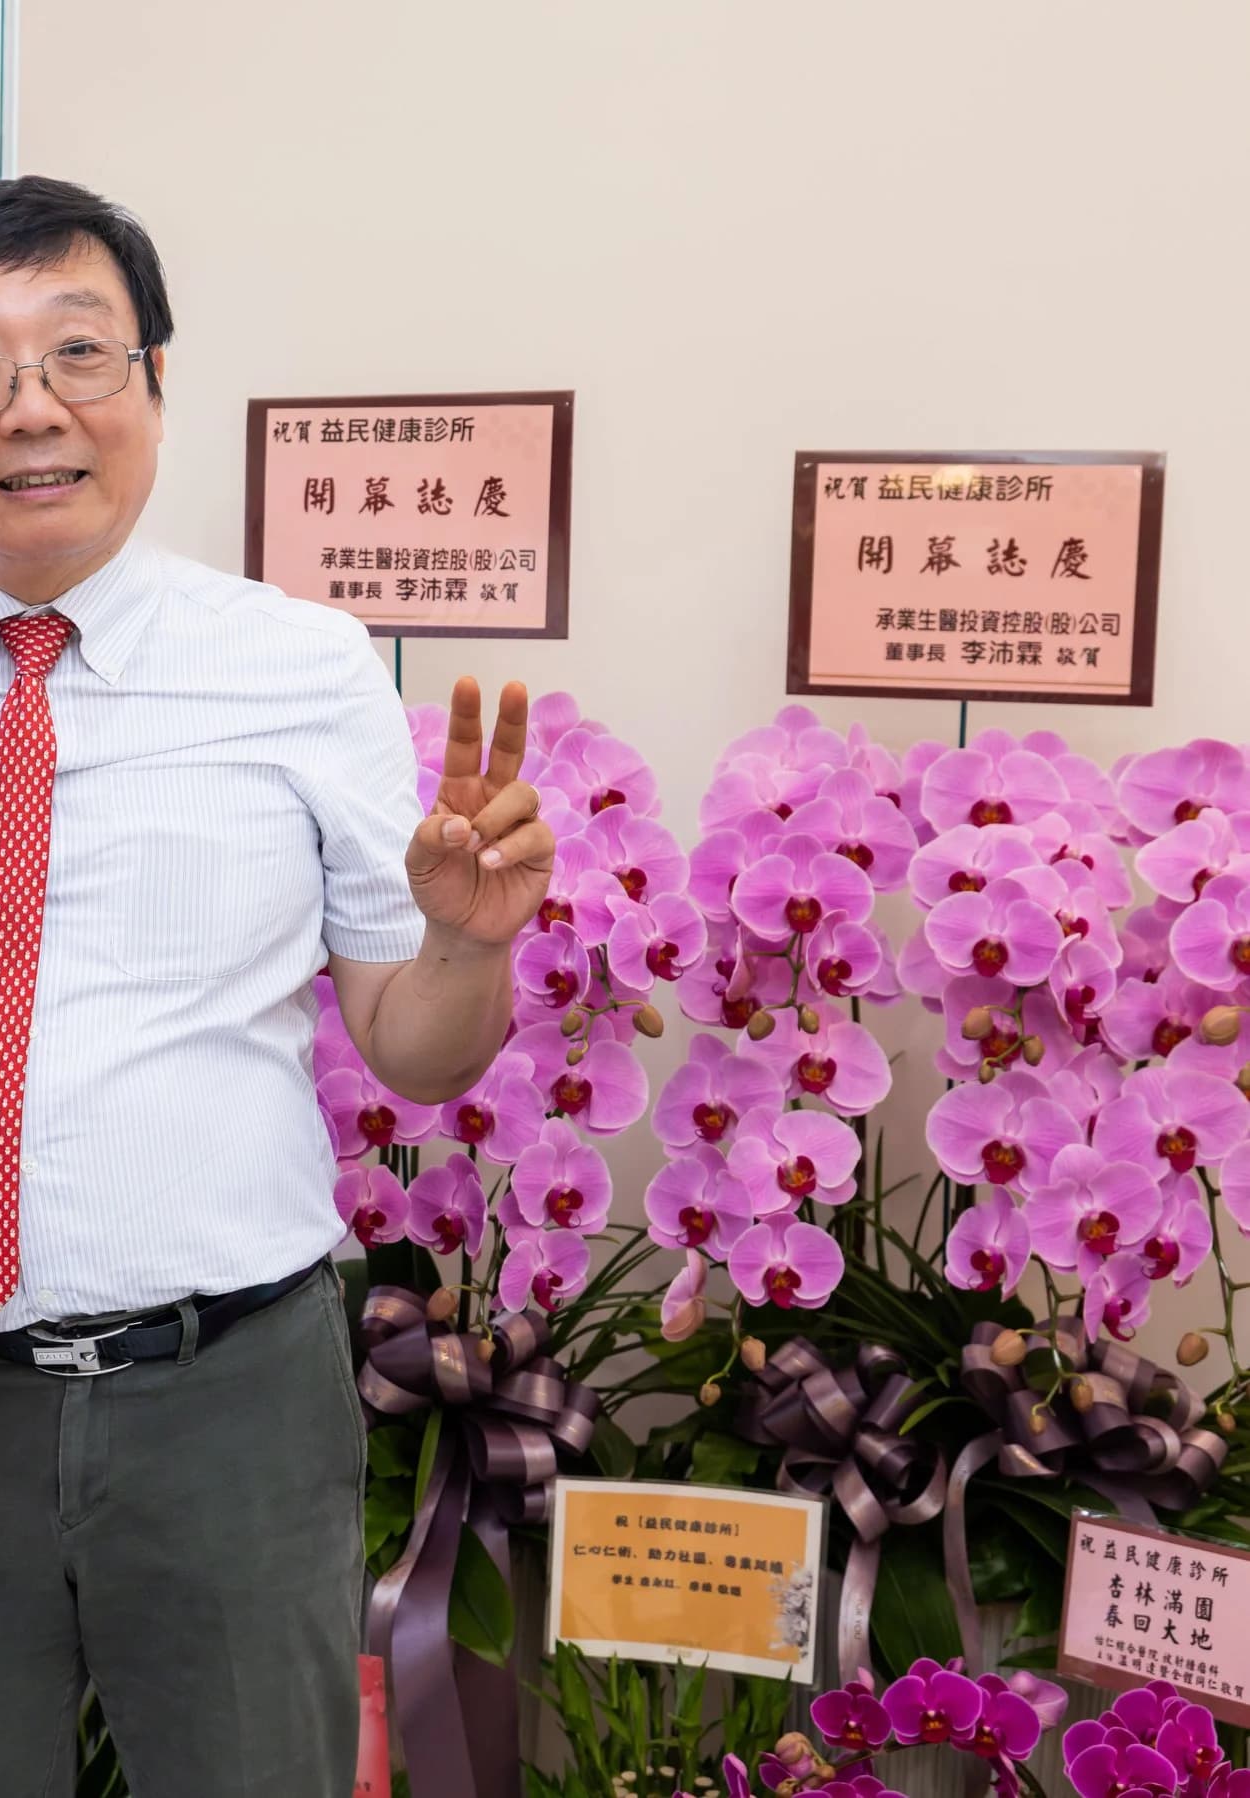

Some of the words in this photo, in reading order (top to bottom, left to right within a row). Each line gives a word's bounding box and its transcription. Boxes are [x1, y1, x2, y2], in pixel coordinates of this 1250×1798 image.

[272, 420, 312, 443] 祝賀
[320, 416, 475, 443] 益民健康診所
[303, 476, 511, 517] 開幕誌慶
[823, 476, 868, 500] 祝賀
[878, 474, 1053, 501] 益民健康診所
[320, 547, 537, 572] 承業生醫投資控股(股)公司
[857, 535, 1093, 580] 開幕誌慶
[329, 580, 382, 600] 董事長
[395, 577, 468, 602] 李沛霖
[479, 582, 519, 602] 敬賀
[875, 608, 1121, 637] 承業生醫投資控股(股)公司
[885, 642, 946, 663] 董事長
[960, 640, 1043, 666] 李沛霖
[1057, 647, 1101, 668] 敬賀
[1108, 1573, 1214, 1622] 杏林滿園
[1104, 1604, 1213, 1652] 春回大地
